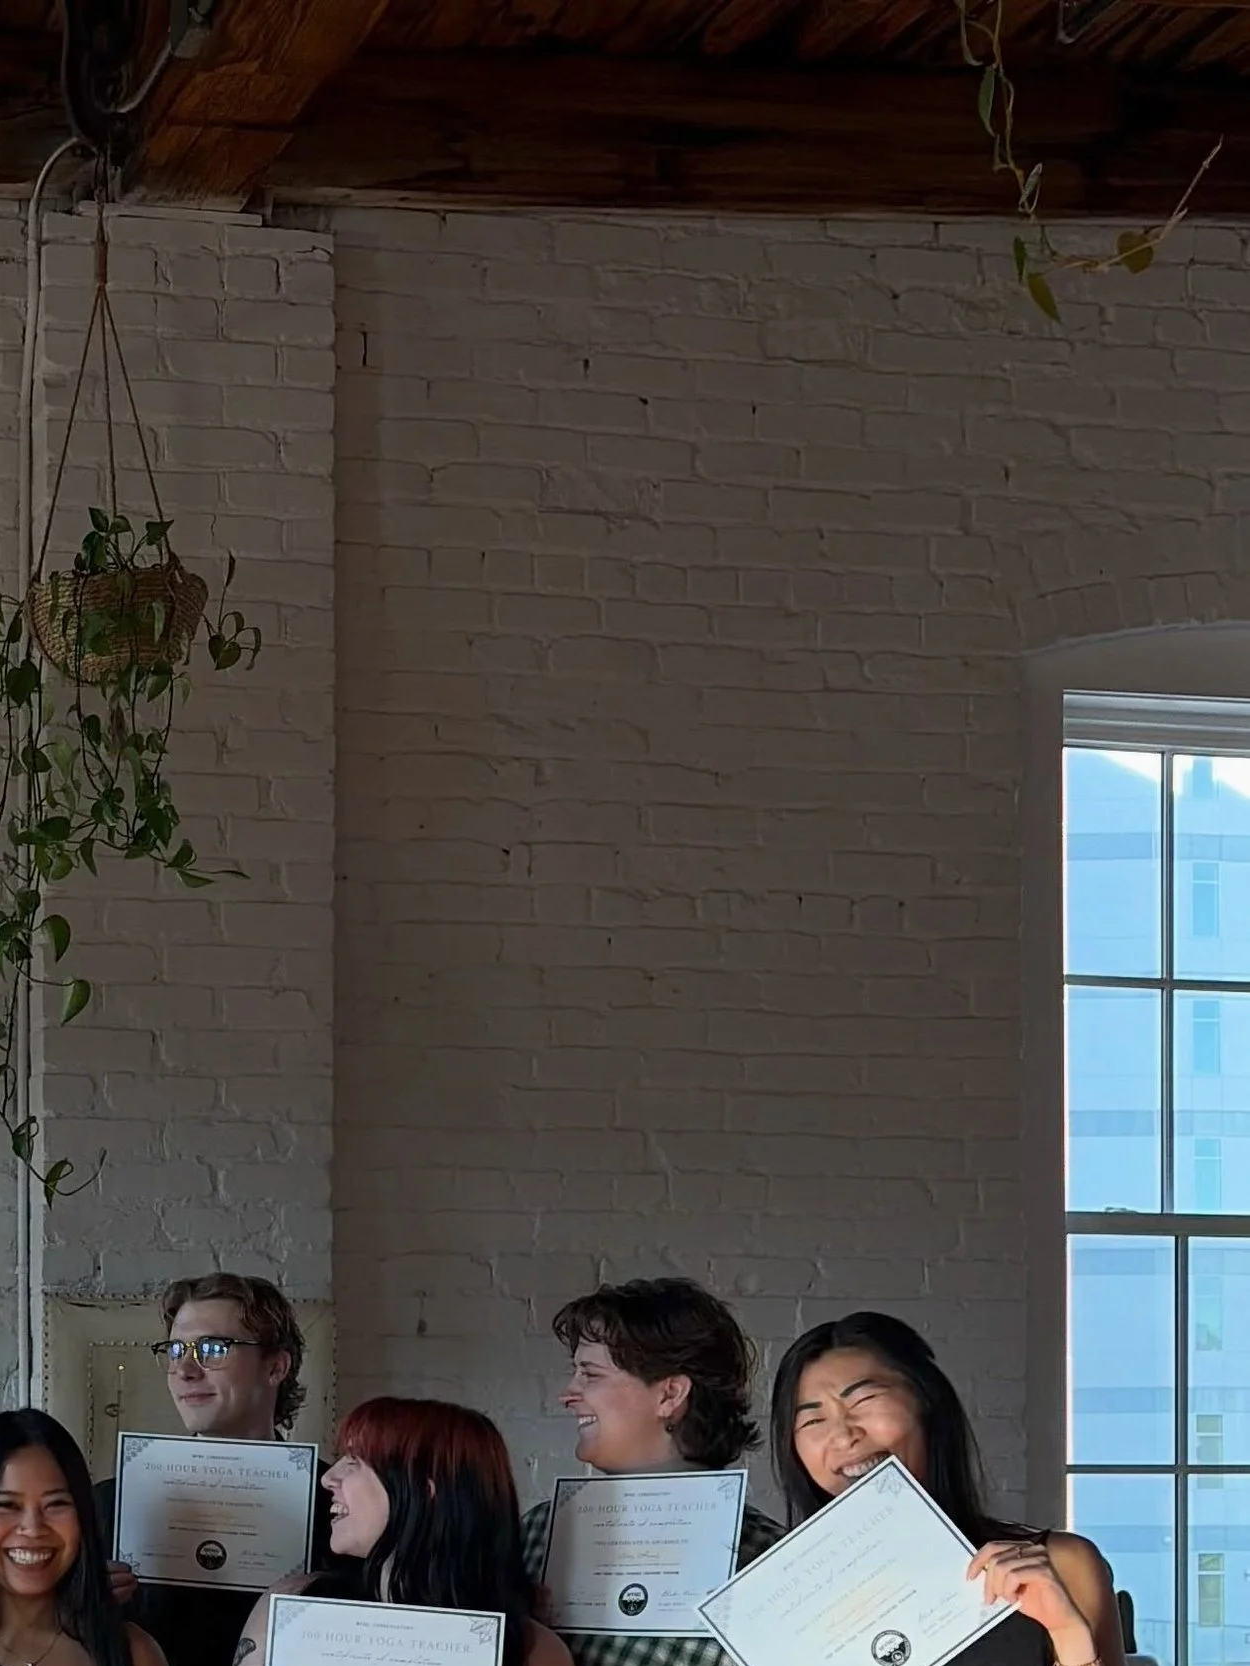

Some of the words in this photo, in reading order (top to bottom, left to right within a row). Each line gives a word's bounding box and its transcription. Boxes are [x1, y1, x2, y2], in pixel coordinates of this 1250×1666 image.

[144, 1462, 162, 1471] 200
[166, 1463, 198, 1473] HOUR
[202, 1465, 234, 1476] YOGA
[237, 1467, 290, 1479] TEACHER
[597, 1503, 628, 1513] HOUR
[633, 1502, 663, 1512] YOGA
[667, 1501, 717, 1511] TEACHER
[766, 1574, 803, 1606] HOUR
[839, 1502, 895, 1549] TEACHER
[300, 1629, 320, 1641] 200
[325, 1631, 361, 1644] HOUR
[368, 1635, 403, 1648] YOGA
[410, 1638, 471, 1654] TEACHER
